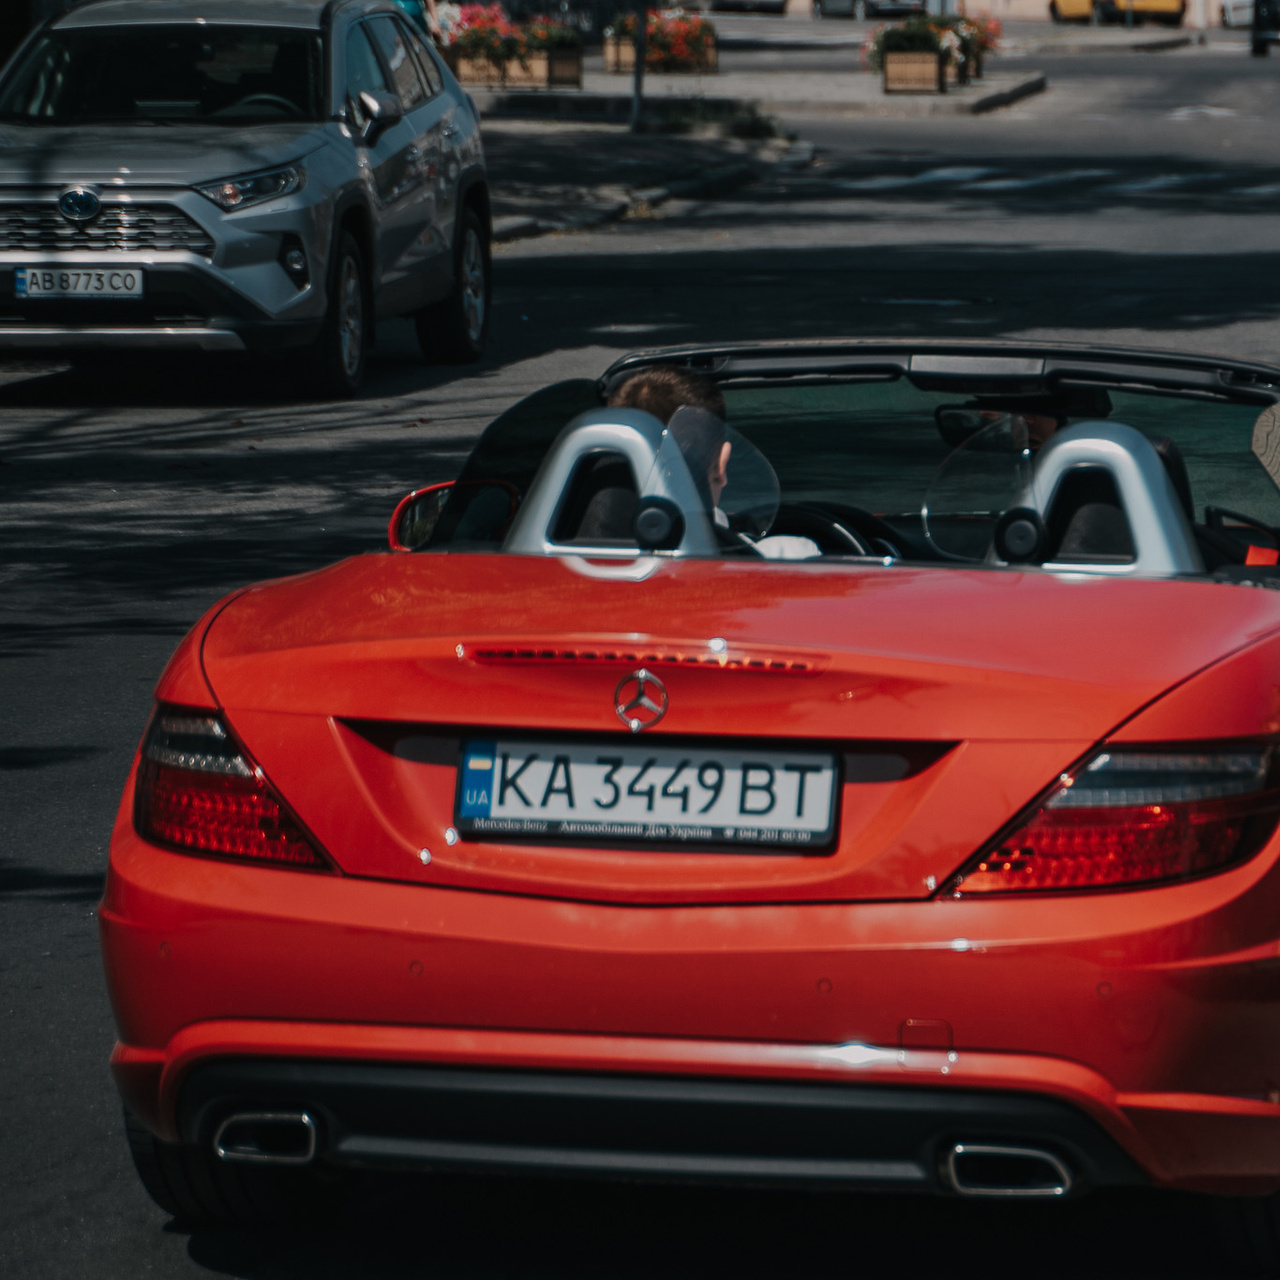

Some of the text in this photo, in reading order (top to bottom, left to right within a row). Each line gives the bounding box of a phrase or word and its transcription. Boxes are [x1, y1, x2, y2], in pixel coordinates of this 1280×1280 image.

[60, 272, 104, 291] 8773
[498, 752, 823, 817] KA 3449 BT
[465, 789, 489, 805] UA
